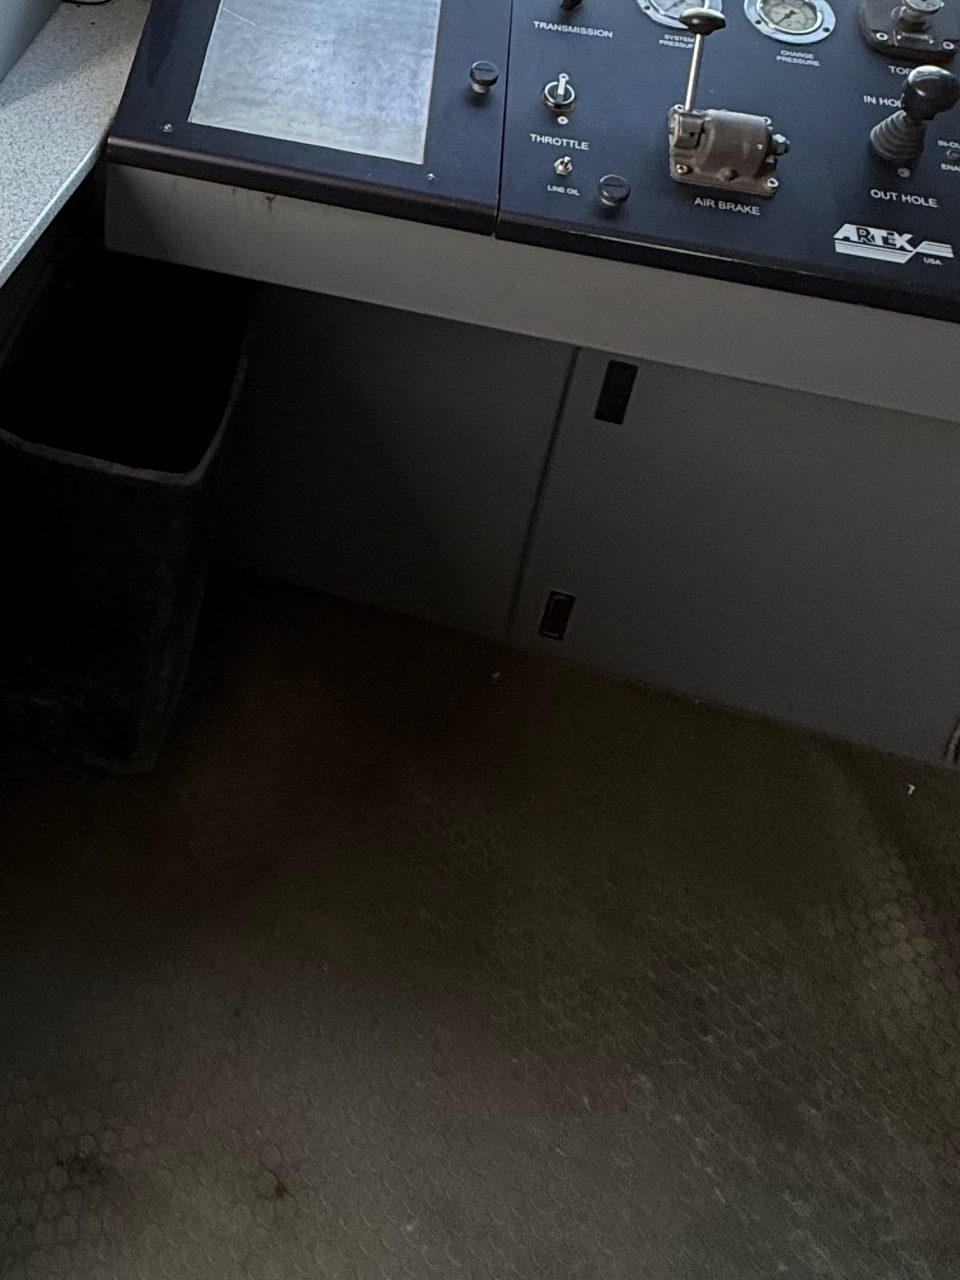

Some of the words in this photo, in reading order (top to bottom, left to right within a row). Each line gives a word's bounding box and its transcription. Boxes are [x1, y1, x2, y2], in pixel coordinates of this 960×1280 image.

[533, 21, 613, 38] TRANSMISSION
[664, 34, 695, 43] SYSTEM
[780, 49, 814, 59] CHARGE
[776, 55, 821, 67] PRESSURE
[863, 95, 876, 104] IN
[530, 133, 590, 151] THROTTLE
[547, 184, 565, 194] LINE
[566, 188, 581, 197] OIL
[870, 189, 898, 201] OUT
[901, 193, 939, 208] HOLE
[694, 196, 716, 209] AIR
[718, 201, 761, 216] BRAKE
[833, 223, 915, 252] ARTEX
[923, 257, 942, 266] USA
